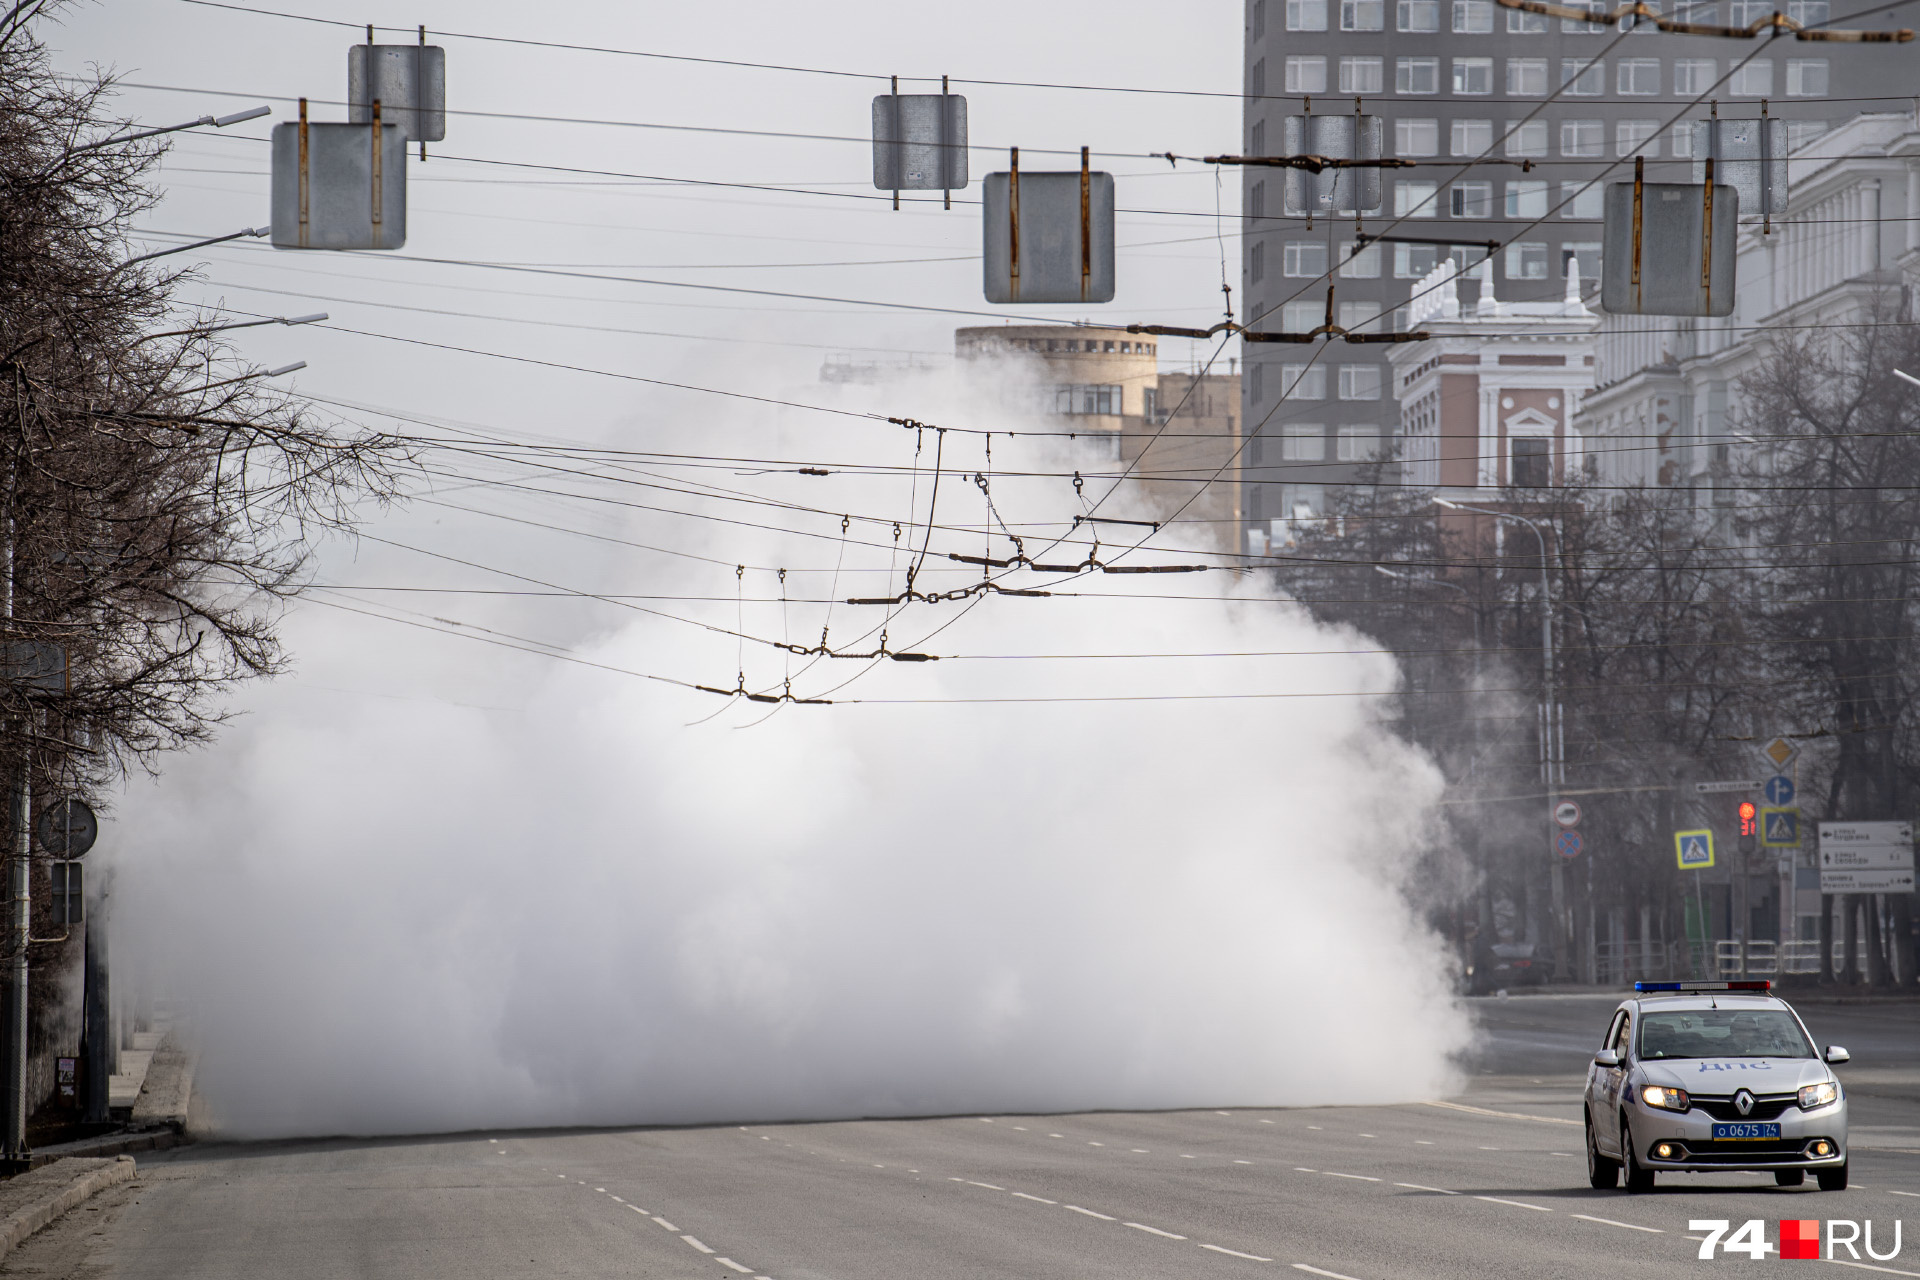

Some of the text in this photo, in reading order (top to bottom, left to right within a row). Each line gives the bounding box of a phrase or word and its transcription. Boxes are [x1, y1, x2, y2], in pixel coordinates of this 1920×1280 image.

[1699, 1063, 1772, 1072] ДПС
[1729, 1125, 1759, 1136] 0675
[1765, 1124, 1777, 1133] 74
